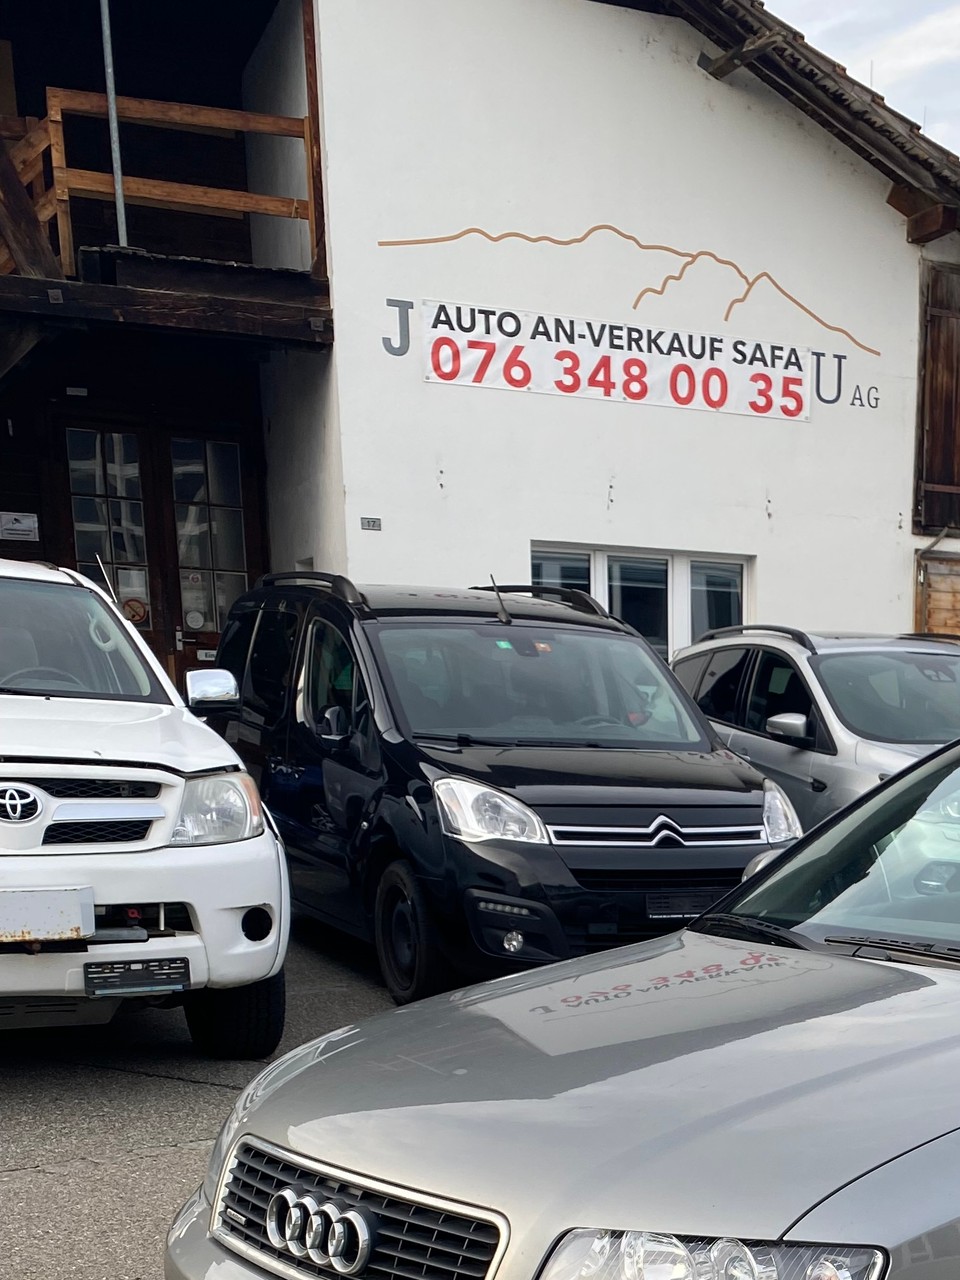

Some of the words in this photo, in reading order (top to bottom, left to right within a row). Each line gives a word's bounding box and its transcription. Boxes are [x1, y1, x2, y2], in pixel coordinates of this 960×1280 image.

[431, 304, 522, 338] AUTO
[530, 315, 723, 361] AN-VERKAUF
[732, 340, 803, 372] SAFA
[430, 336, 532, 388] 076
[555, 350, 648, 401] 348
[669, 364, 728, 409] 00
[749, 373, 803, 417] 35
[850, 384, 880, 409] AG
[367, 520, 376, 528] 17
